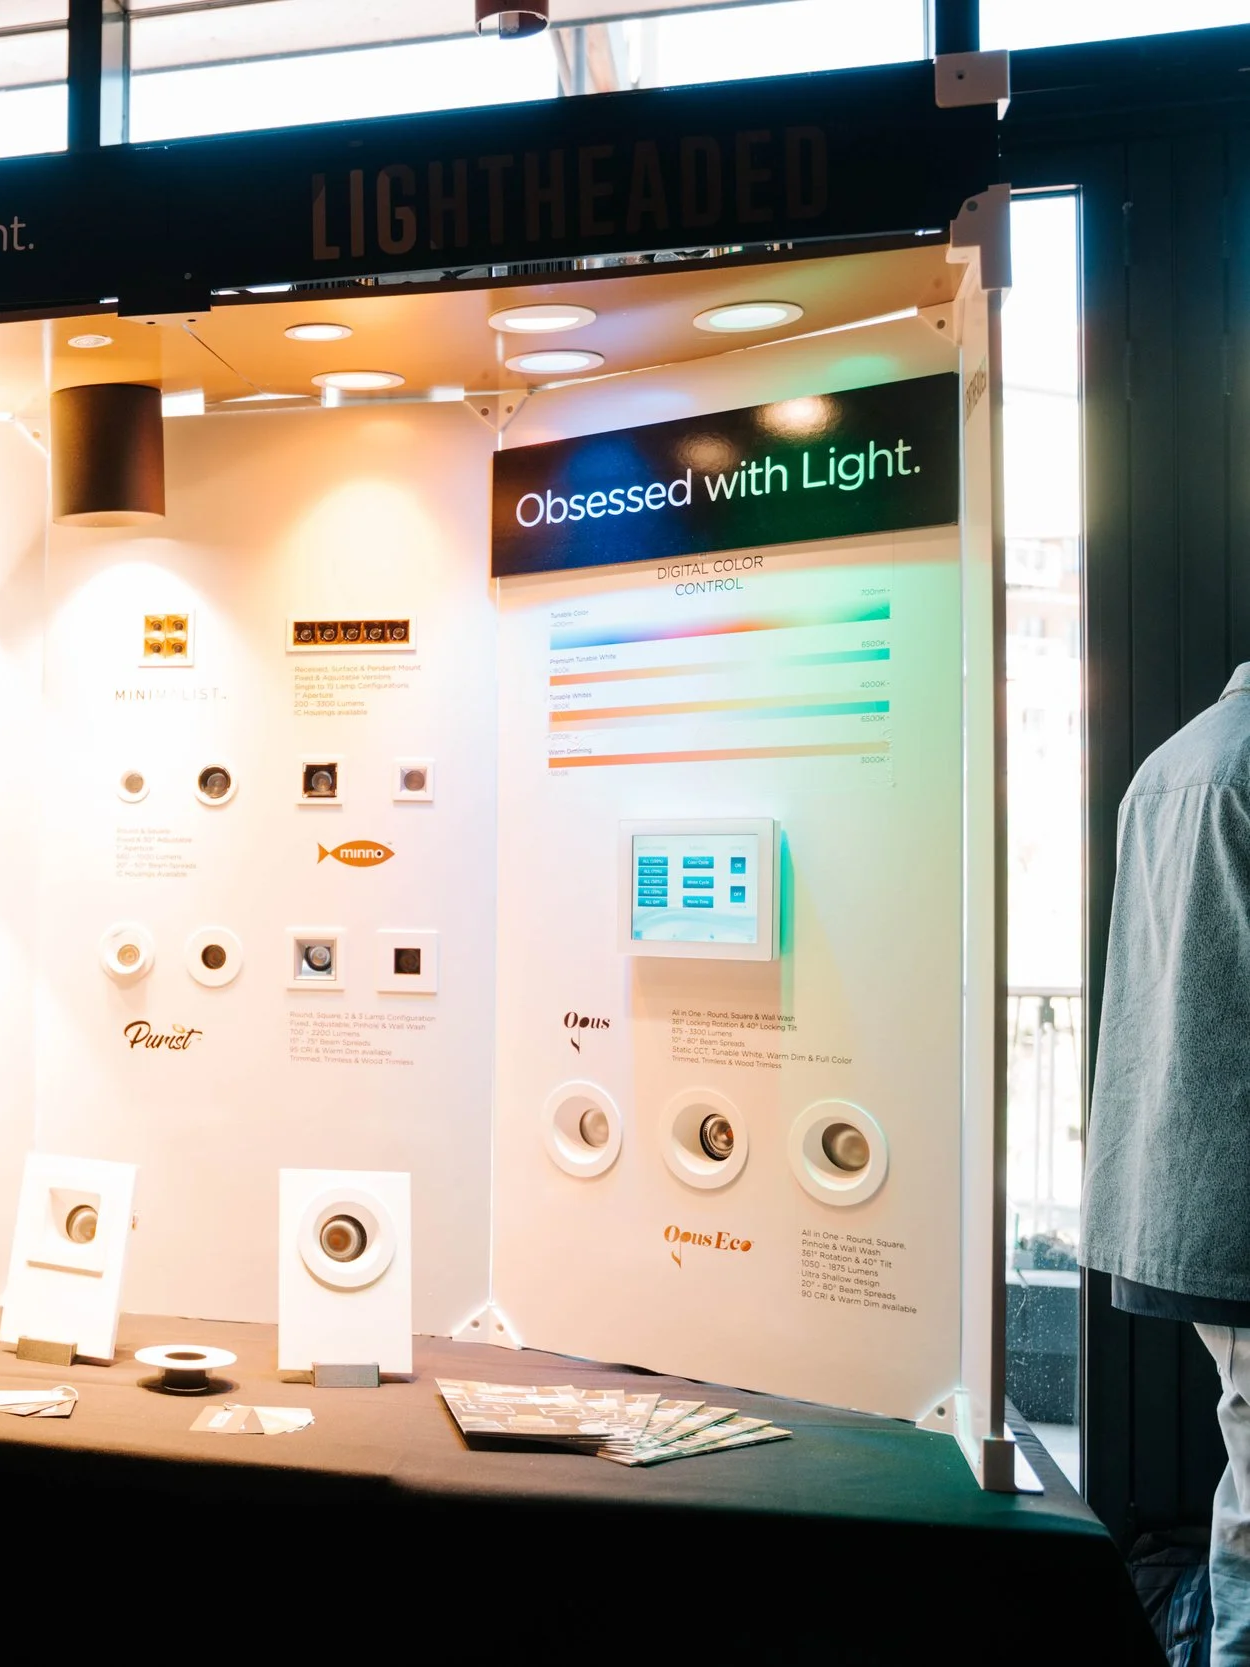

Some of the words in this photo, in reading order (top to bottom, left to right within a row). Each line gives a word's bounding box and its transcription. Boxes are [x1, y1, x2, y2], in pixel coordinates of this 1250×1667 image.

[312, 126, 828, 260] LIGHTHEADED
[515, 468, 693, 529] Obsessed
[703, 455, 788, 503] with
[801, 438, 921, 492] Light.
[657, 562, 708, 580] DIGITAL
[713, 555, 764, 573] COLOR
[674, 577, 744, 596] CONTROL
[862, 640, 886, 648] 6500K
[860, 680, 885, 688] 4000K
[340, 848, 384, 859] minno
[386, 1014, 436, 1023] Configuration
[730, 1013, 754, 1021] Square
[686, 1019, 711, 1028] Locking
[760, 1023, 786, 1032] Locking
[124, 1020, 203, 1050] Purist
[342, 1039, 371, 1047] Spreads
[719, 1040, 745, 1048] Spreads
[672, 1056, 701, 1064] Trimmed,
[756, 1061, 782, 1069] Trimless
[693, 1048, 710, 1056] CCT,
[711, 1049, 740, 1057] Tunable
[741, 1051, 765, 1059] White,
[766, 1052, 789, 1060] Warm
[831, 1056, 852, 1064] Color
[714, 1231, 752, 1252] Eco
[801, 1230, 812, 1238] All
[822, 1232, 840, 1241] One
[845, 1235, 875, 1246] Round,
[876, 1239, 906, 1251] Square,
[802, 1239, 830, 1249] Pinhole
[839, 1244, 857, 1253] Wall
[858, 1247, 881, 1256] Wash
[801, 1250, 818, 1258] 361°
[819, 1252, 853, 1263] Rotation
[862, 1258, 878, 1266] 40°
[879, 1260, 892, 1268] Tilt
[801, 1260, 821, 1269] 1050
[828, 1263, 846, 1272] 1875
[847, 1266, 878, 1276] Lumens
[801, 1270, 820, 1278] Ultra
[821, 1272, 852, 1283] Shallow
[853, 1277, 880, 1288] design
[838, 1286, 862, 1295] Beam
[863, 1289, 896, 1302] Spreads
[814, 1293, 828, 1301] CRI
[837, 1296, 862, 1306] Warm
[863, 1300, 880, 1308] Dim
[881, 1302, 917, 1313] available
